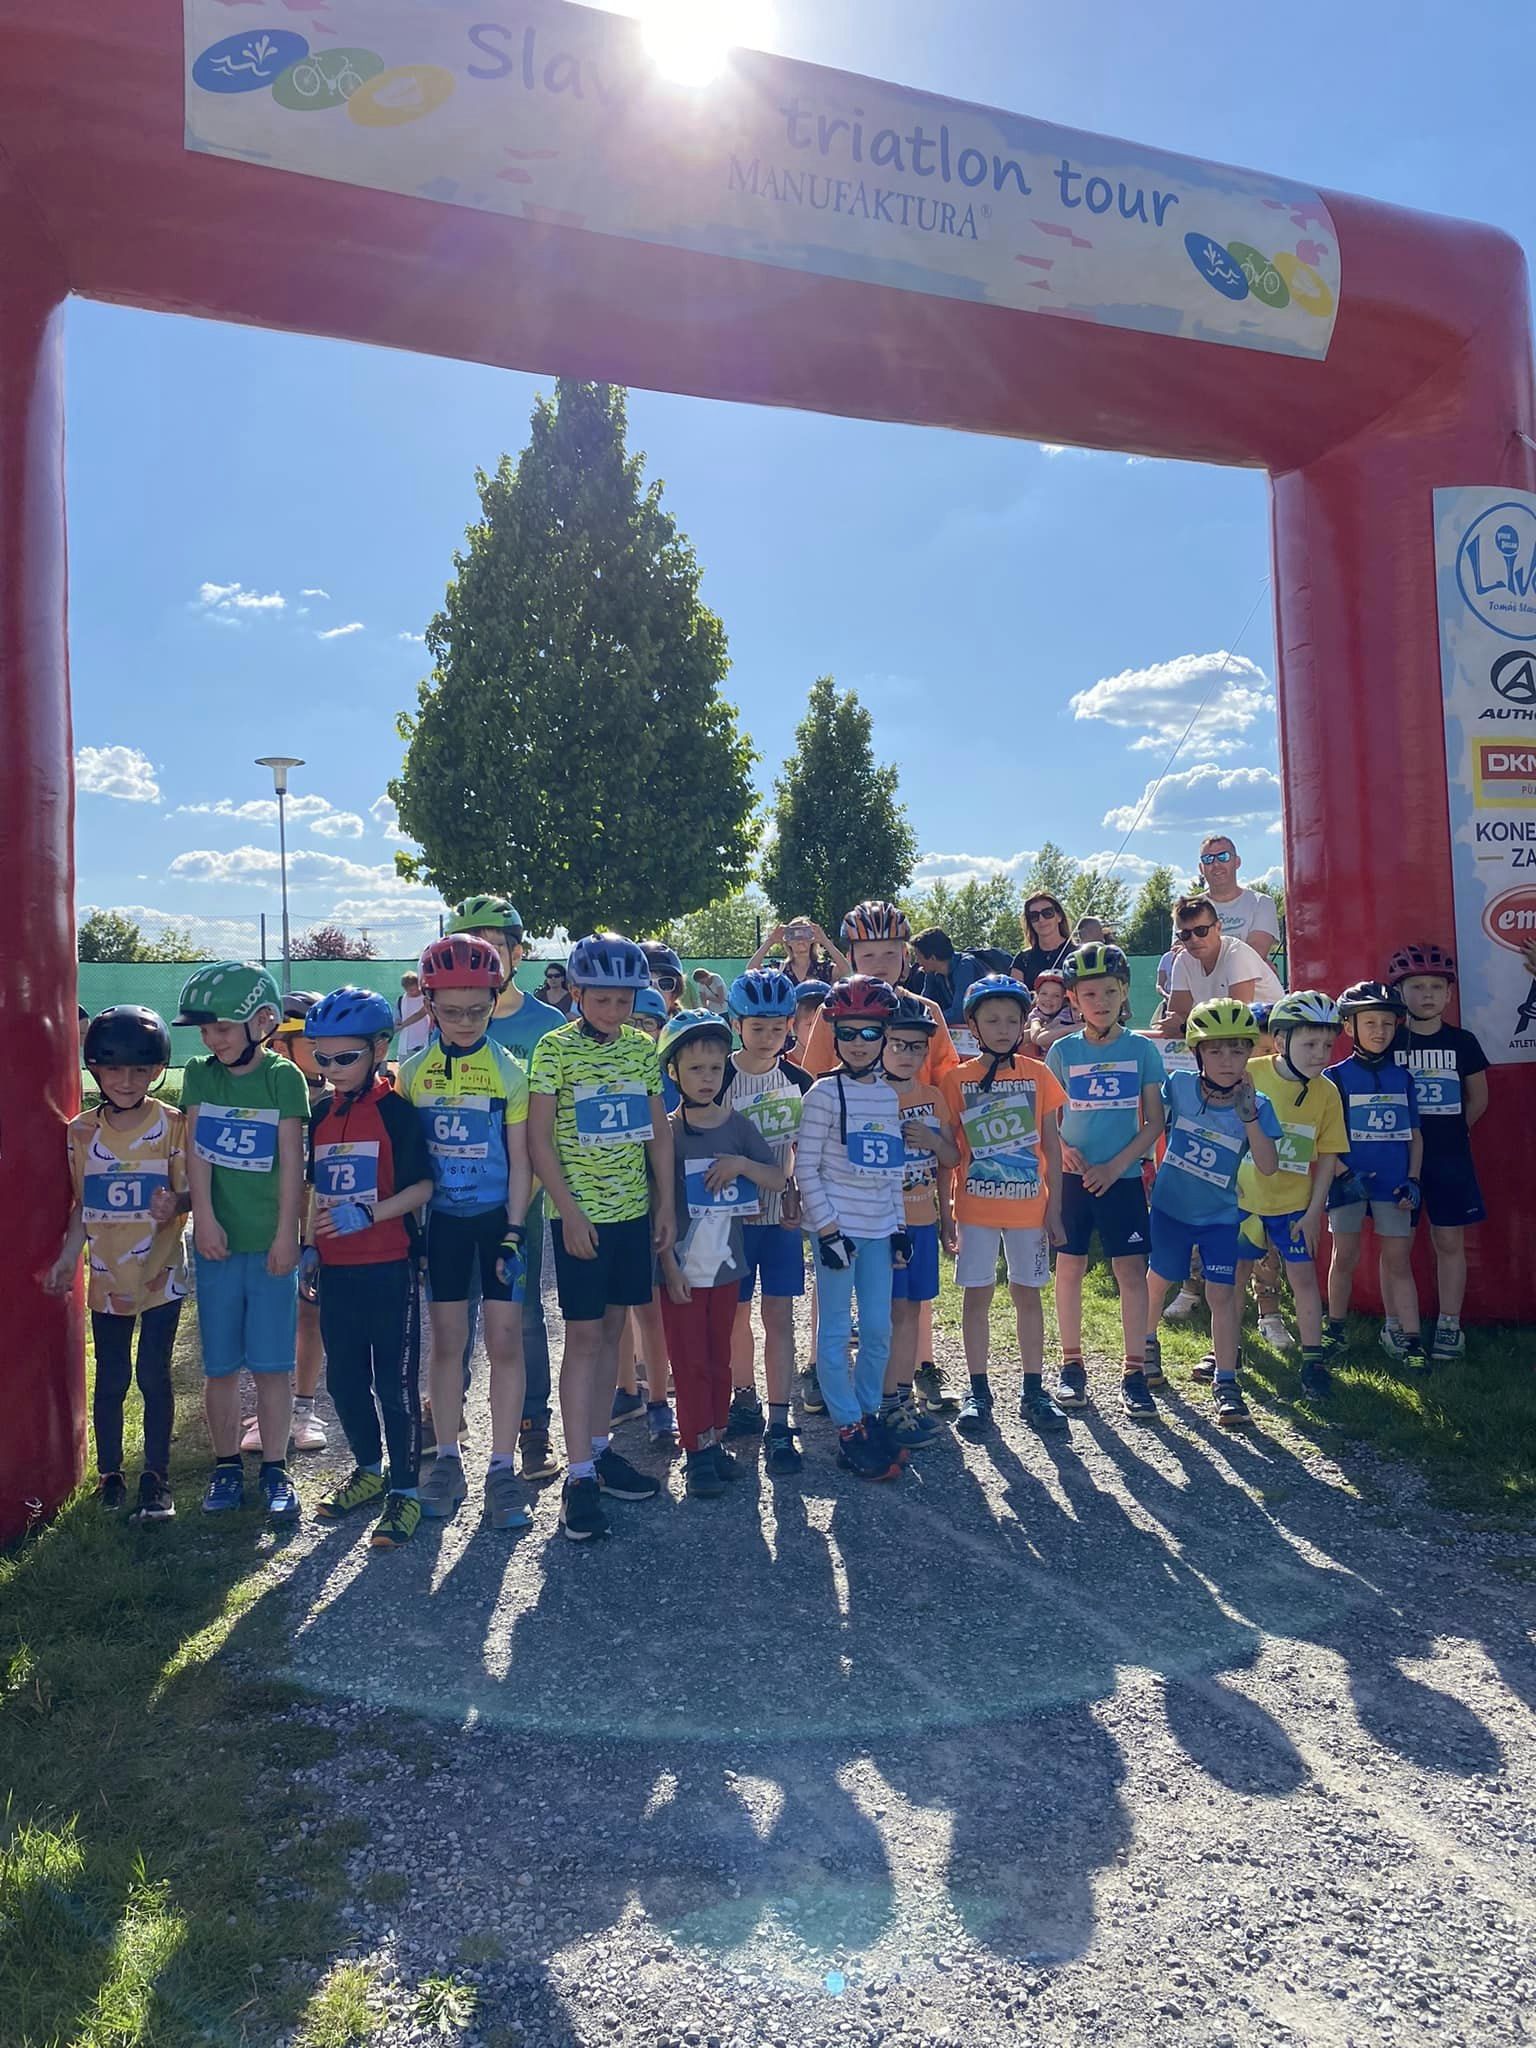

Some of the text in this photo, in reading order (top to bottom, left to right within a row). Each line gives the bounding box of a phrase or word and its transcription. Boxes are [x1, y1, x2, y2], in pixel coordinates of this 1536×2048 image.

[778, 99, 1032, 196] triatlon
[1053, 159, 1180, 227] tour
[1465, 525, 1536, 598] Liv
[1478, 708, 1536, 721] AUTH
[234, 977, 270, 1015] woom
[1393, 1049, 1457, 1070] PUMA
[990, 1078, 1037, 1093] surfing
[1088, 1077, 1120, 1097] 43
[1414, 1083, 1443, 1102] 23
[434, 1114, 469, 1141] 64
[599, 1101, 629, 1129] 21
[748, 1105, 796, 1133] 142
[976, 1113, 1025, 1143] 102
[1367, 1110, 1397, 1130] 49
[215, 1126, 257, 1155] 45
[862, 1139, 890, 1165] 53
[1183, 1139, 1217, 1168] 29
[327, 1163, 357, 1191] 73
[966, 1178, 1041, 1200] academy
[107, 1180, 142, 1207] 61
